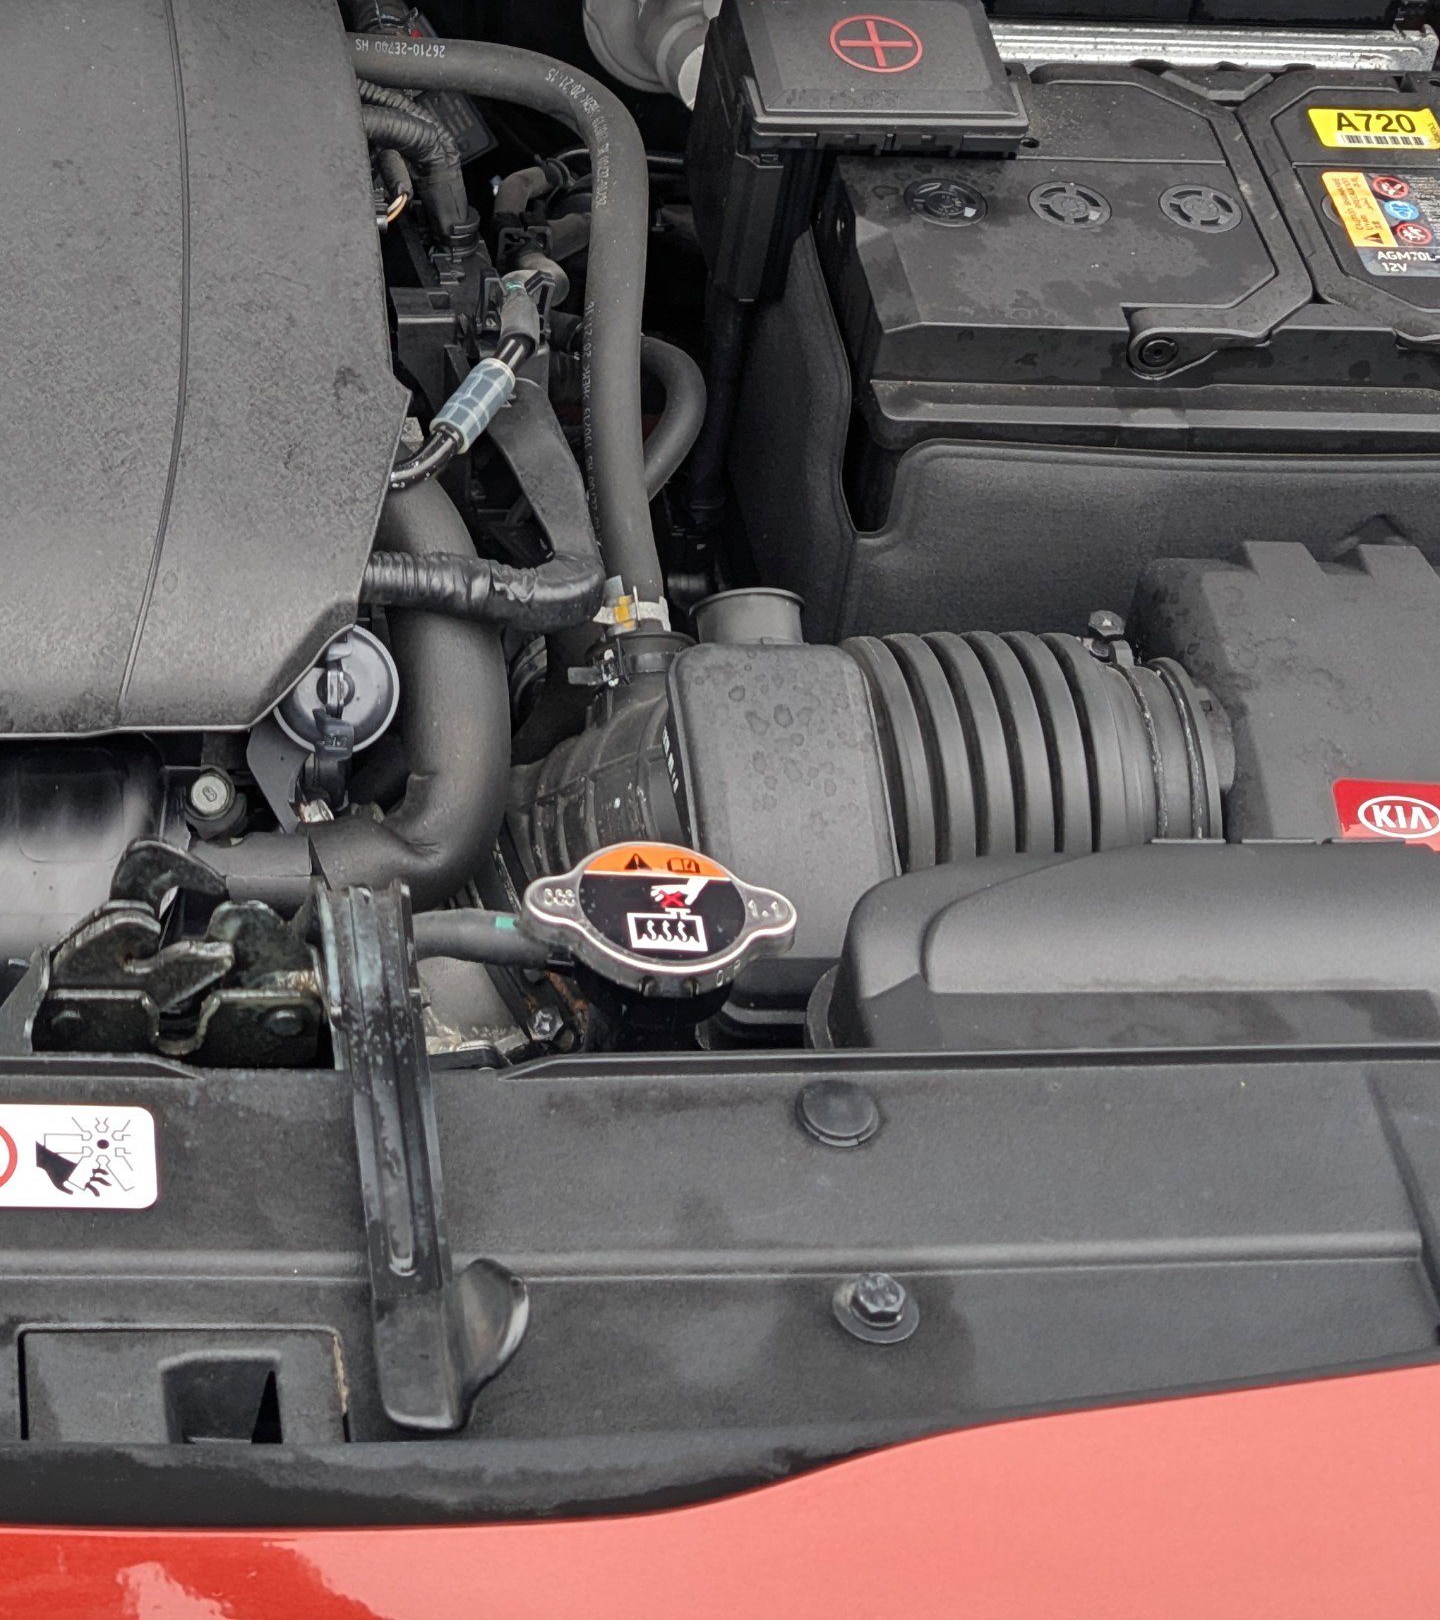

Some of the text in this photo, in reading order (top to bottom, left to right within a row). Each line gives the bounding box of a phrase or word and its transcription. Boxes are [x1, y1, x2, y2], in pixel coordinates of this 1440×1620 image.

[1336, 112, 1417, 134] A720
[1382, 262, 1408, 272] 12V
[1370, 804, 1433, 830] KIA
